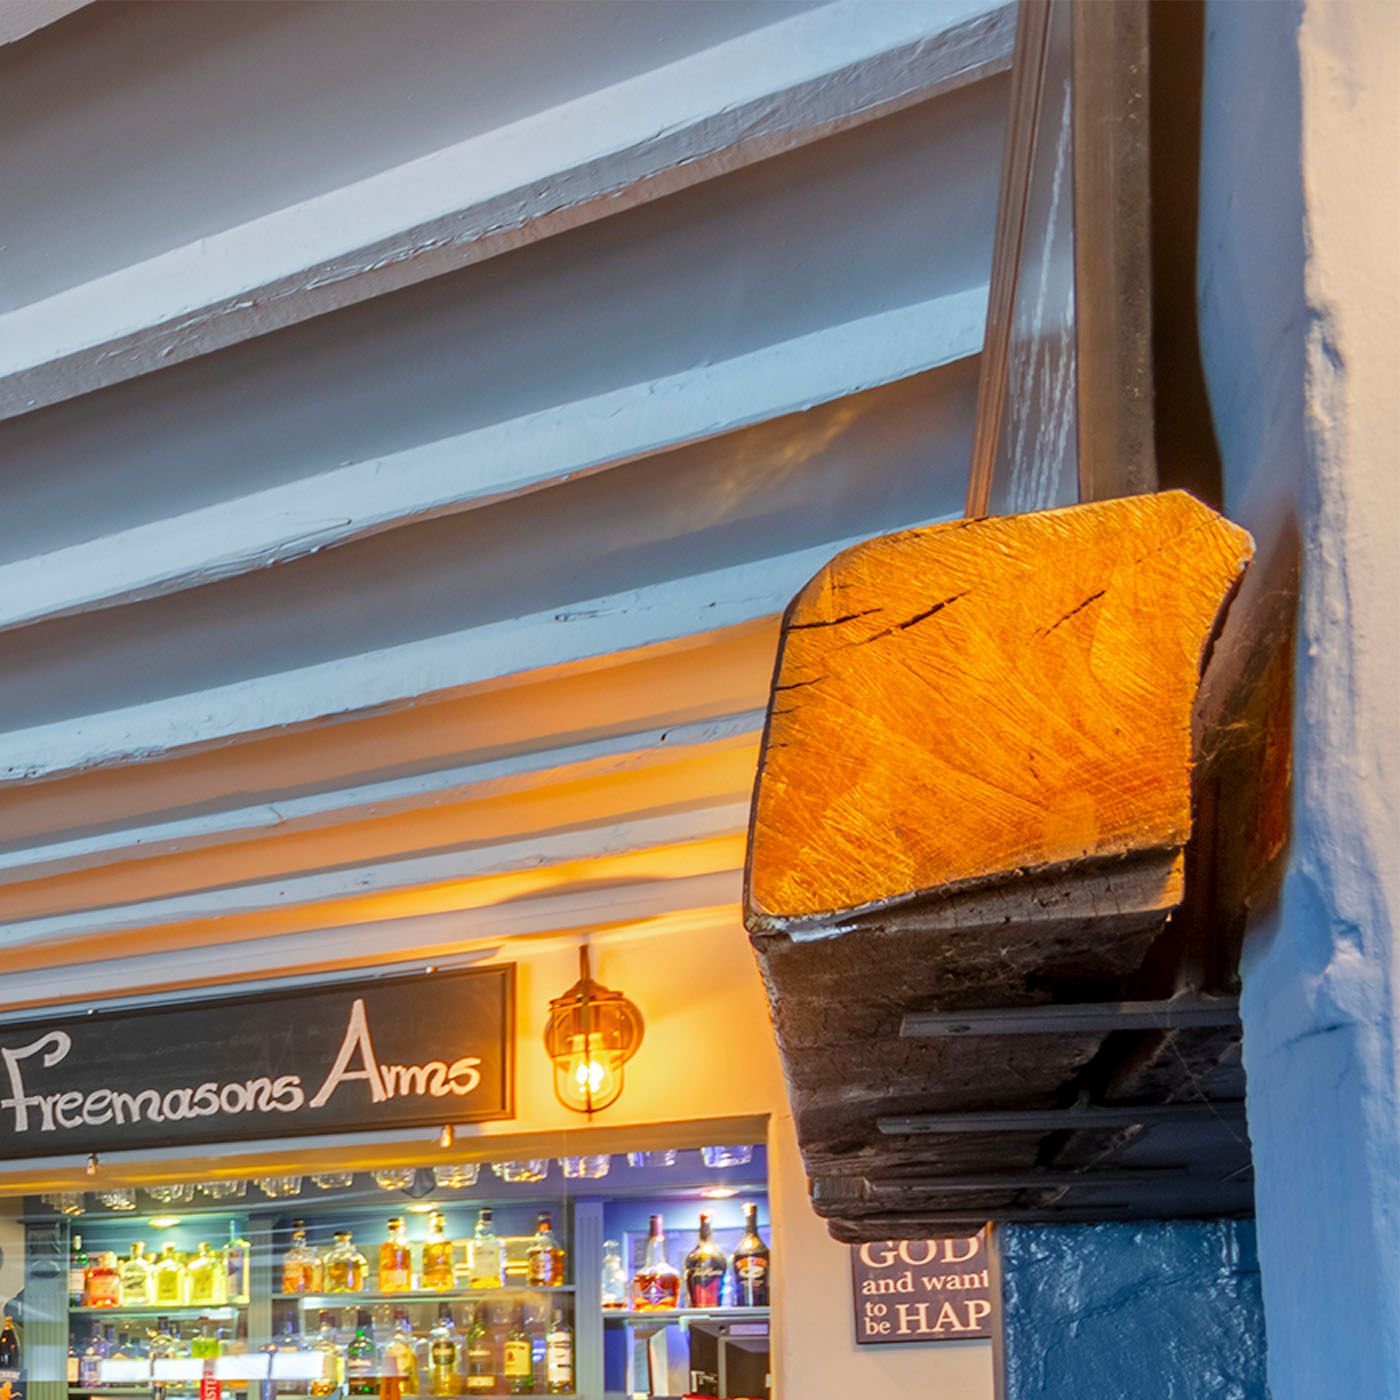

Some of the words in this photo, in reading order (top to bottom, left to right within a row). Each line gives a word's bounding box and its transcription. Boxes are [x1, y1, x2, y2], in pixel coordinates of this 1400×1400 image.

[0, 1030, 305, 1132] Freemasons
[309, 998, 482, 1108] Arms
[859, 1237, 978, 1268] GOD
[861, 1271, 915, 1295] and
[921, 1269, 989, 1291] want
[864, 1301, 887, 1316] to
[864, 1317, 891, 1335] be
